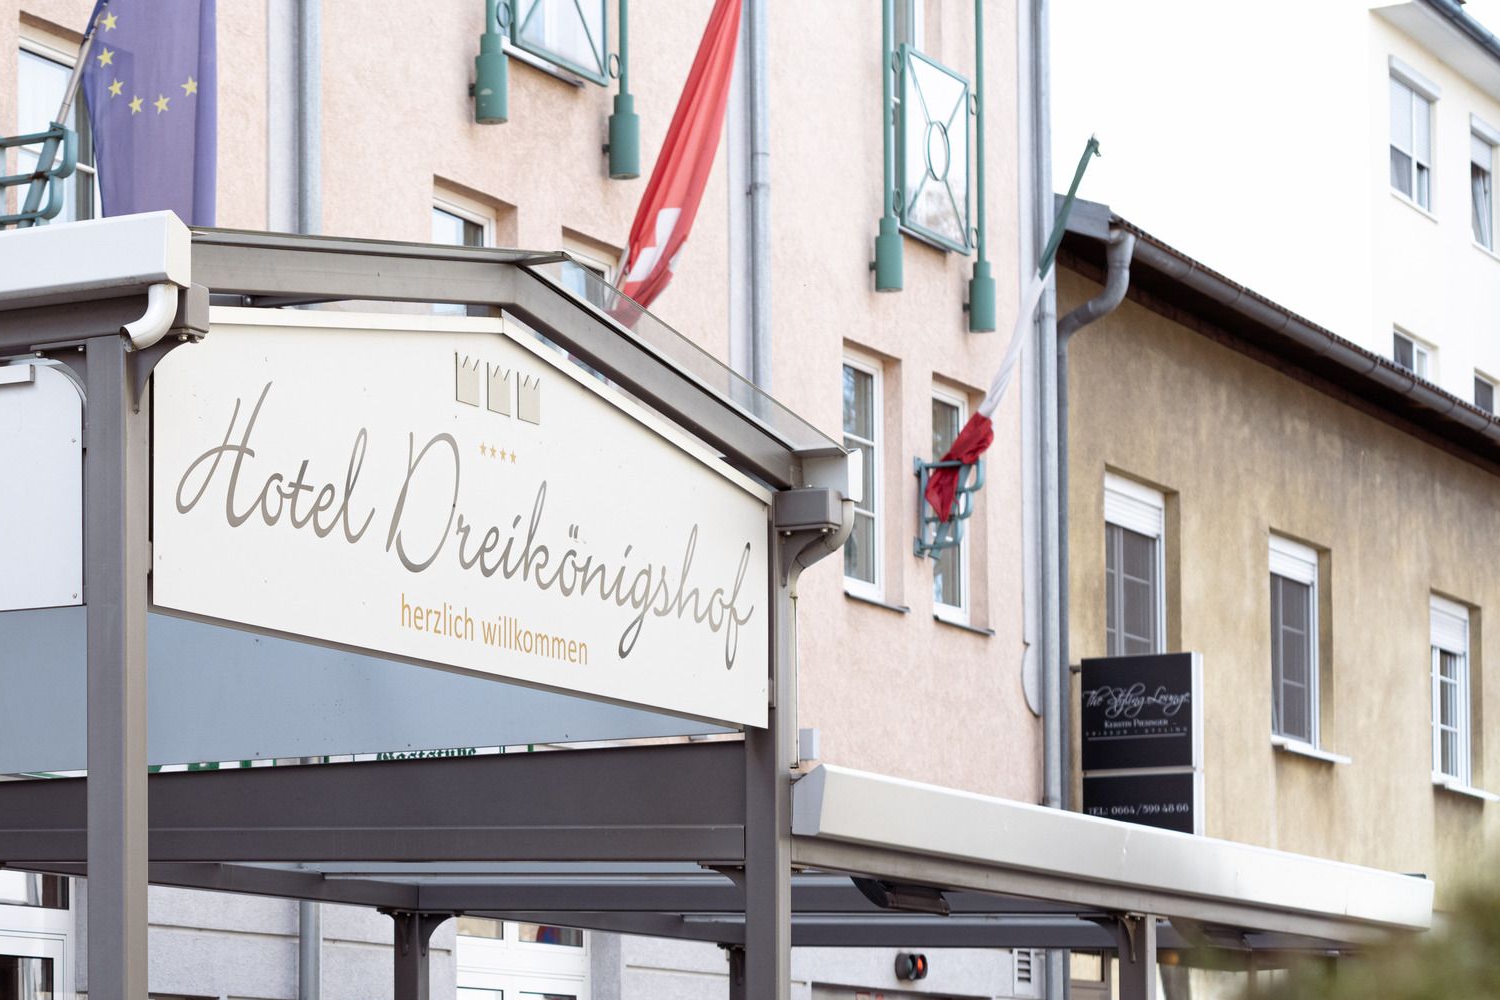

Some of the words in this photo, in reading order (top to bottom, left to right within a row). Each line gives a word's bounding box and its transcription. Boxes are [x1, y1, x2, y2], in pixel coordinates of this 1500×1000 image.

[175, 381, 375, 545] Hotel
[386, 431, 755, 671] Dreikönigshof
[400, 593, 476, 642] herzlich
[481, 616, 588, 666] willkommen
